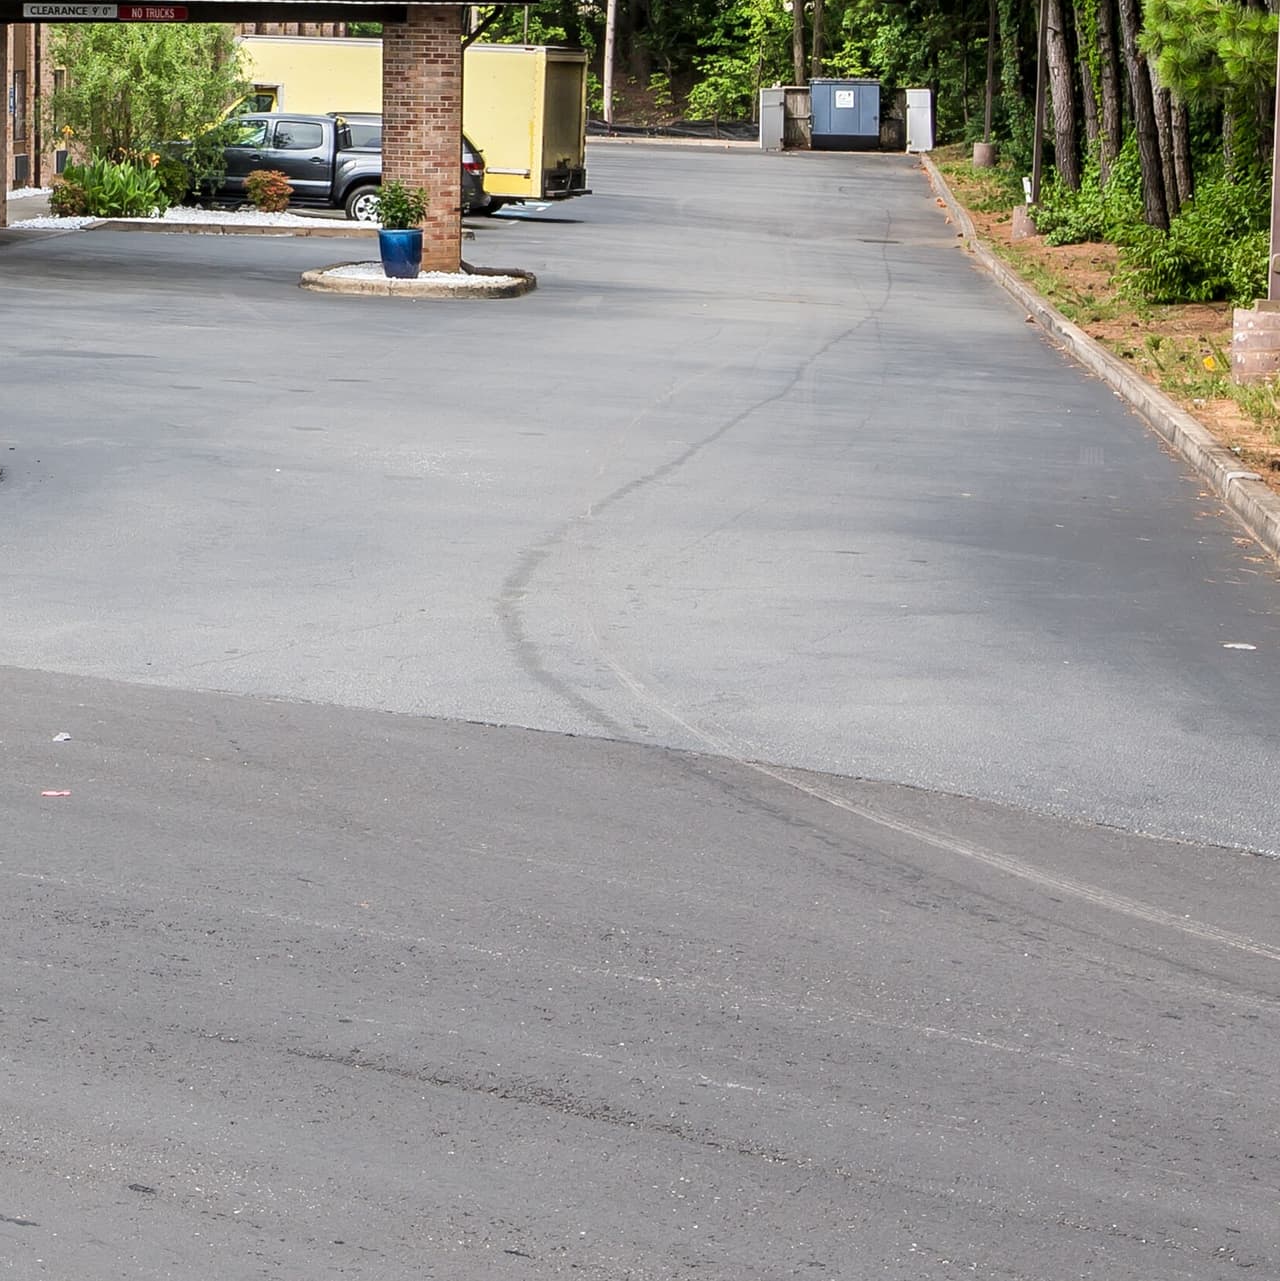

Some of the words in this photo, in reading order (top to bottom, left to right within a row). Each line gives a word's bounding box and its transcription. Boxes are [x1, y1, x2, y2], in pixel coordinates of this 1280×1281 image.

[30, 6, 88, 16] CLEARANCE
[131, 7, 143, 18] NO
[145, 7, 175, 19] TRUCKS
